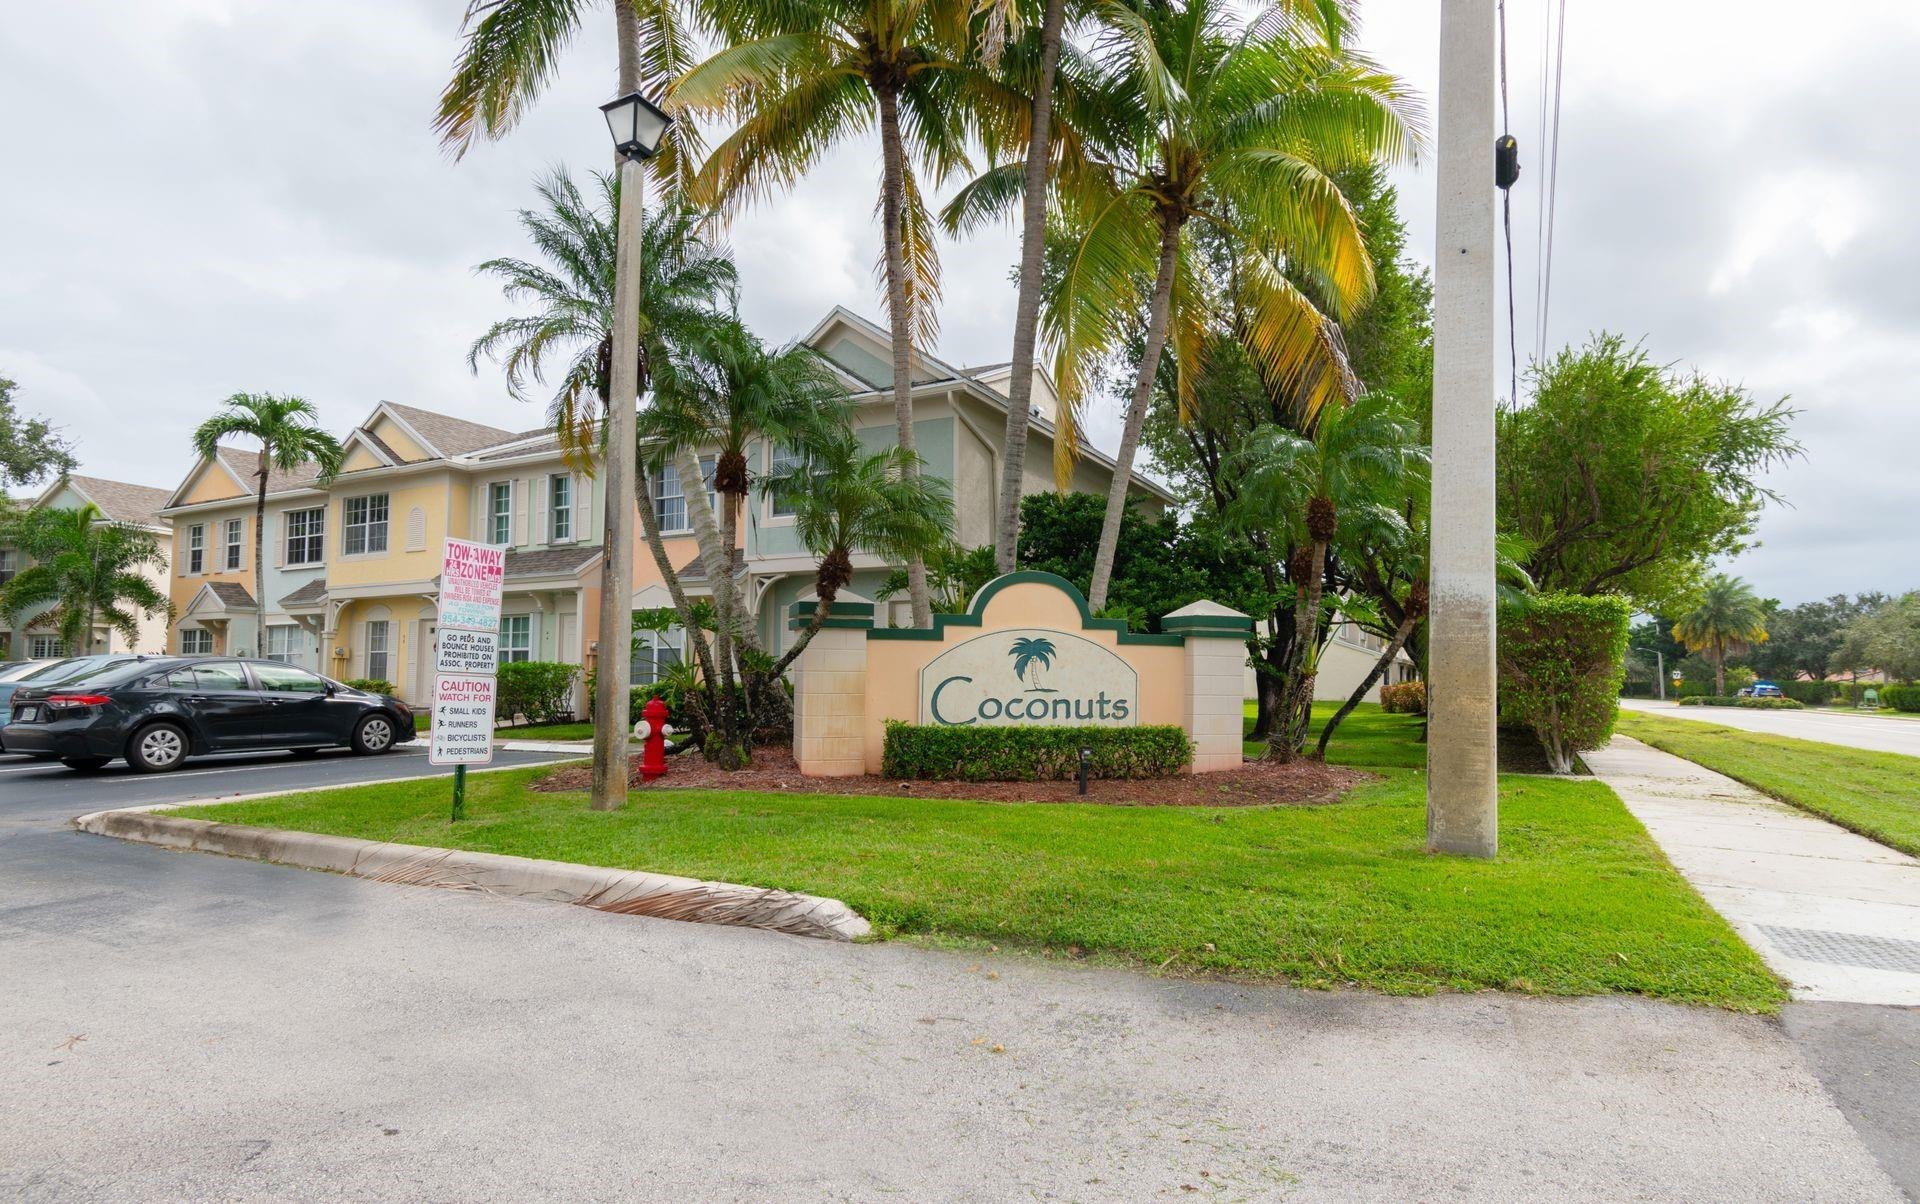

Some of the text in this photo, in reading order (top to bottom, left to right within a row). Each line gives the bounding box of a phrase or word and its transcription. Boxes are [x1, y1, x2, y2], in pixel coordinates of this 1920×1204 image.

[448, 543, 502, 566] TOW-AWAY
[460, 563, 487, 580] ZONE
[447, 634, 492, 644] GO PEDS AND
[442, 642, 494, 652] BOUNCE HOUSES
[443, 650, 492, 661] PROHIBITED ON
[440, 659, 494, 669] ASSOC. PROPERTY
[441, 680, 490, 692] CAUTION
[438, 693, 492, 702] WATCH FOR
[930, 675, 1130, 726] Coconuts
[448, 707, 486, 716] SMALL KIDS
[448, 720, 478, 728] RUNNERS
[447, 734, 486, 742] BICYCLISTS
[446, 747, 488, 755] PEDESTRIANS
